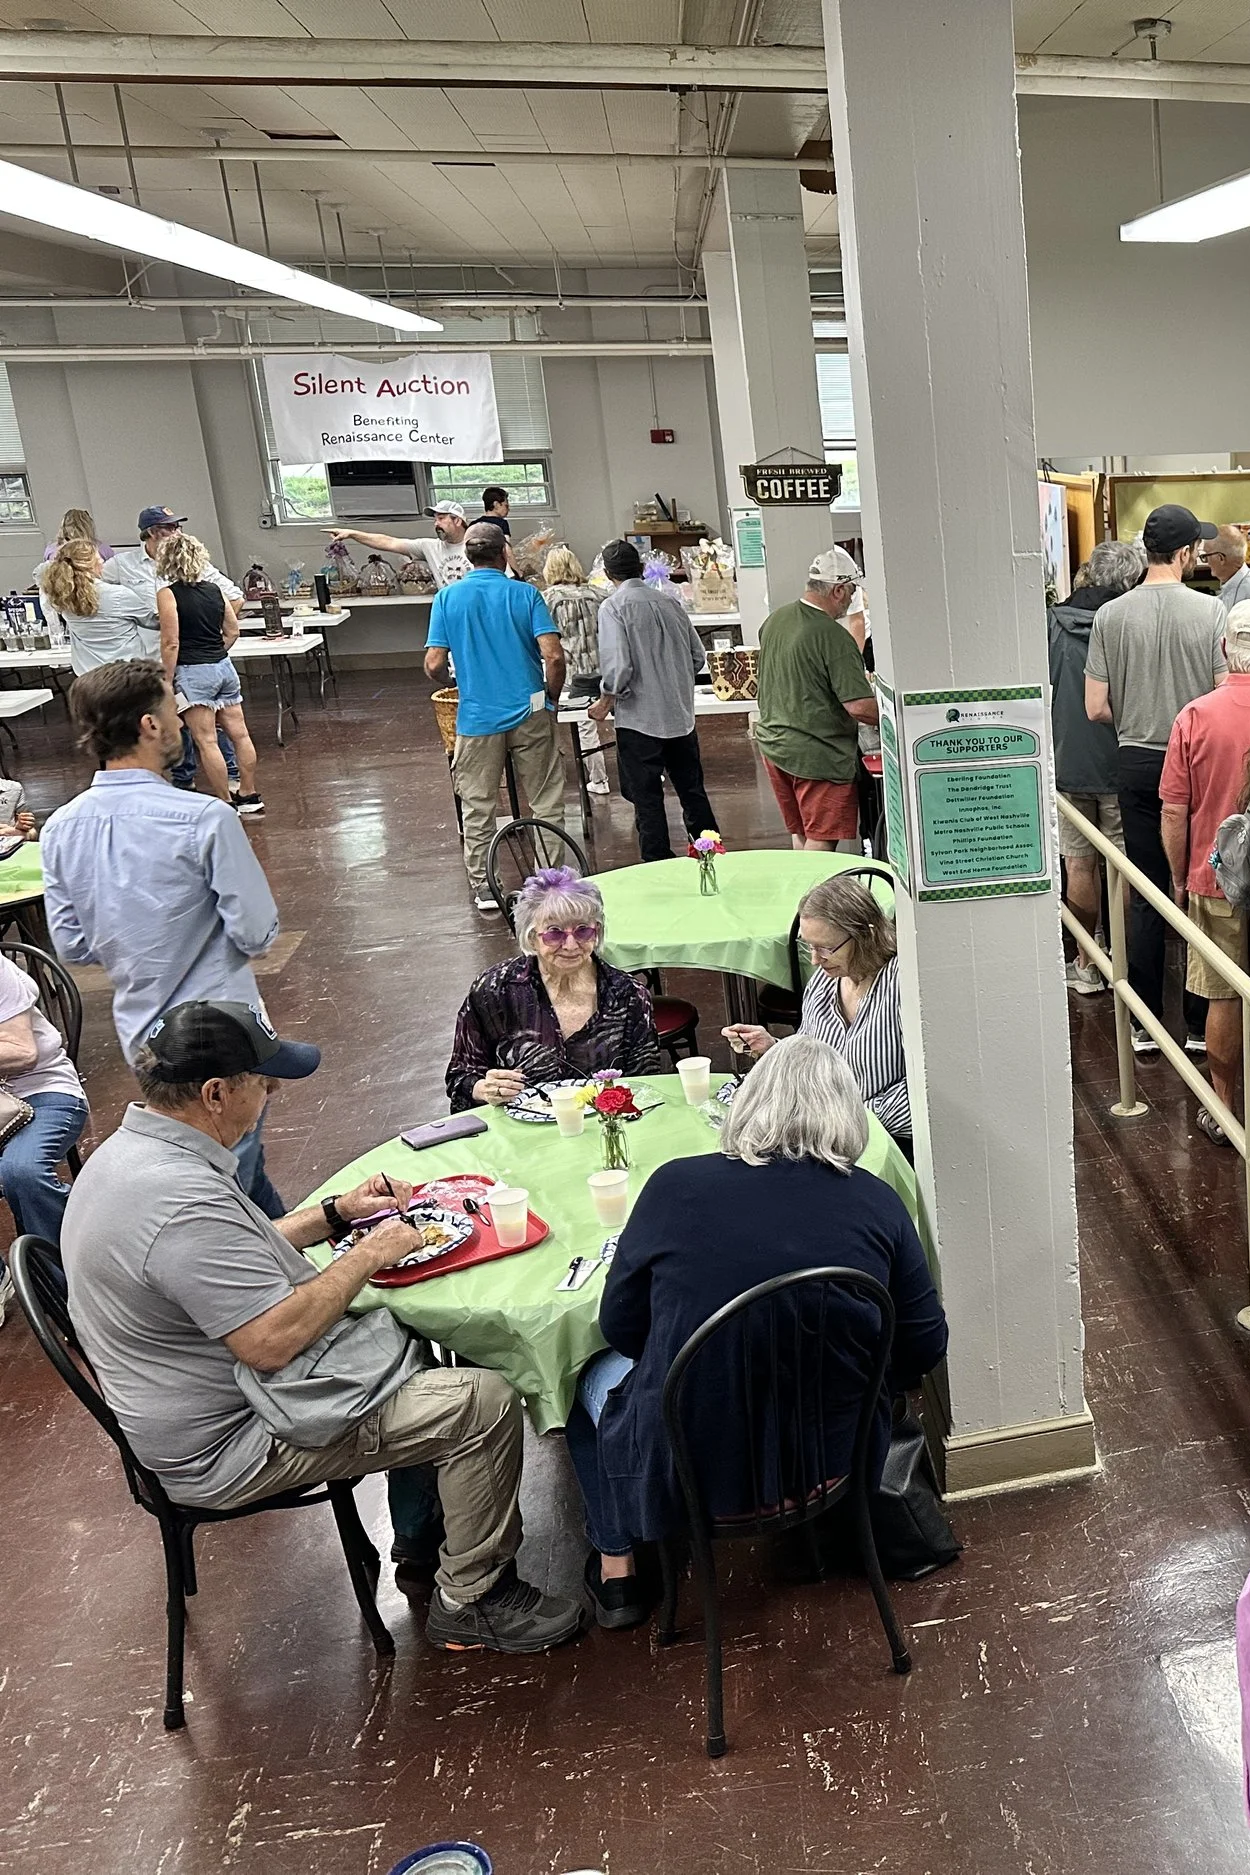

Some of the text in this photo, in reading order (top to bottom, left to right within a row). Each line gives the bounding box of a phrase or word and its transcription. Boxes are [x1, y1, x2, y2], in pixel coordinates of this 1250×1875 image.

[293, 372, 470, 398] Silent Auction
[353, 414, 419, 428] Benefiting
[321, 430, 455, 446] Renaissance Center
[756, 478, 831, 499] COFFEE
[930, 735, 1023, 748] THANK YOU TO OUR
[946, 743, 1008, 754] SUPPORTERS
[975, 773, 1011, 781] Foundation
[970, 844, 1014, 853] Neighborhood
[992, 863, 1028, 871] Foundation
